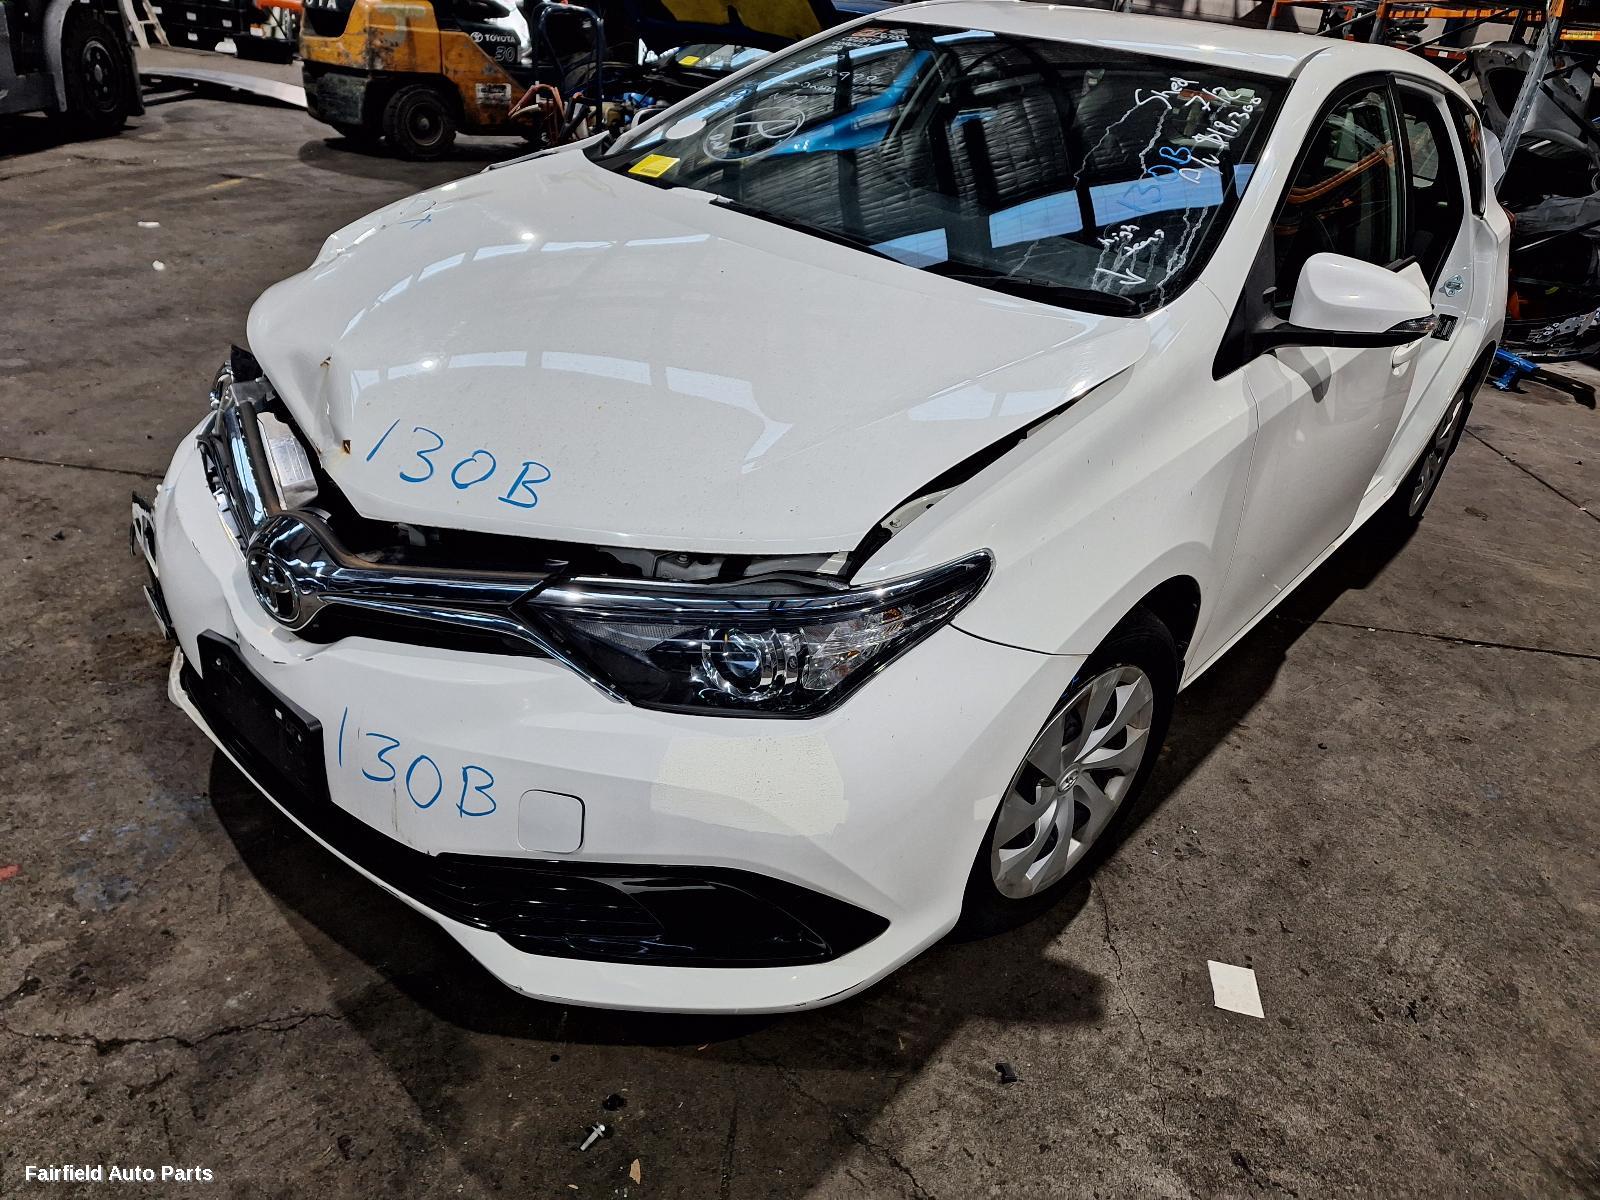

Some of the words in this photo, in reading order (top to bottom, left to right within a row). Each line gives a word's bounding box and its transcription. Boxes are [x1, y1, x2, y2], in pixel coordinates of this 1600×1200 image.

[484, 34, 516, 43] TOYOTA
[366, 418, 551, 508] 130B
[338, 705, 497, 818] 130B
